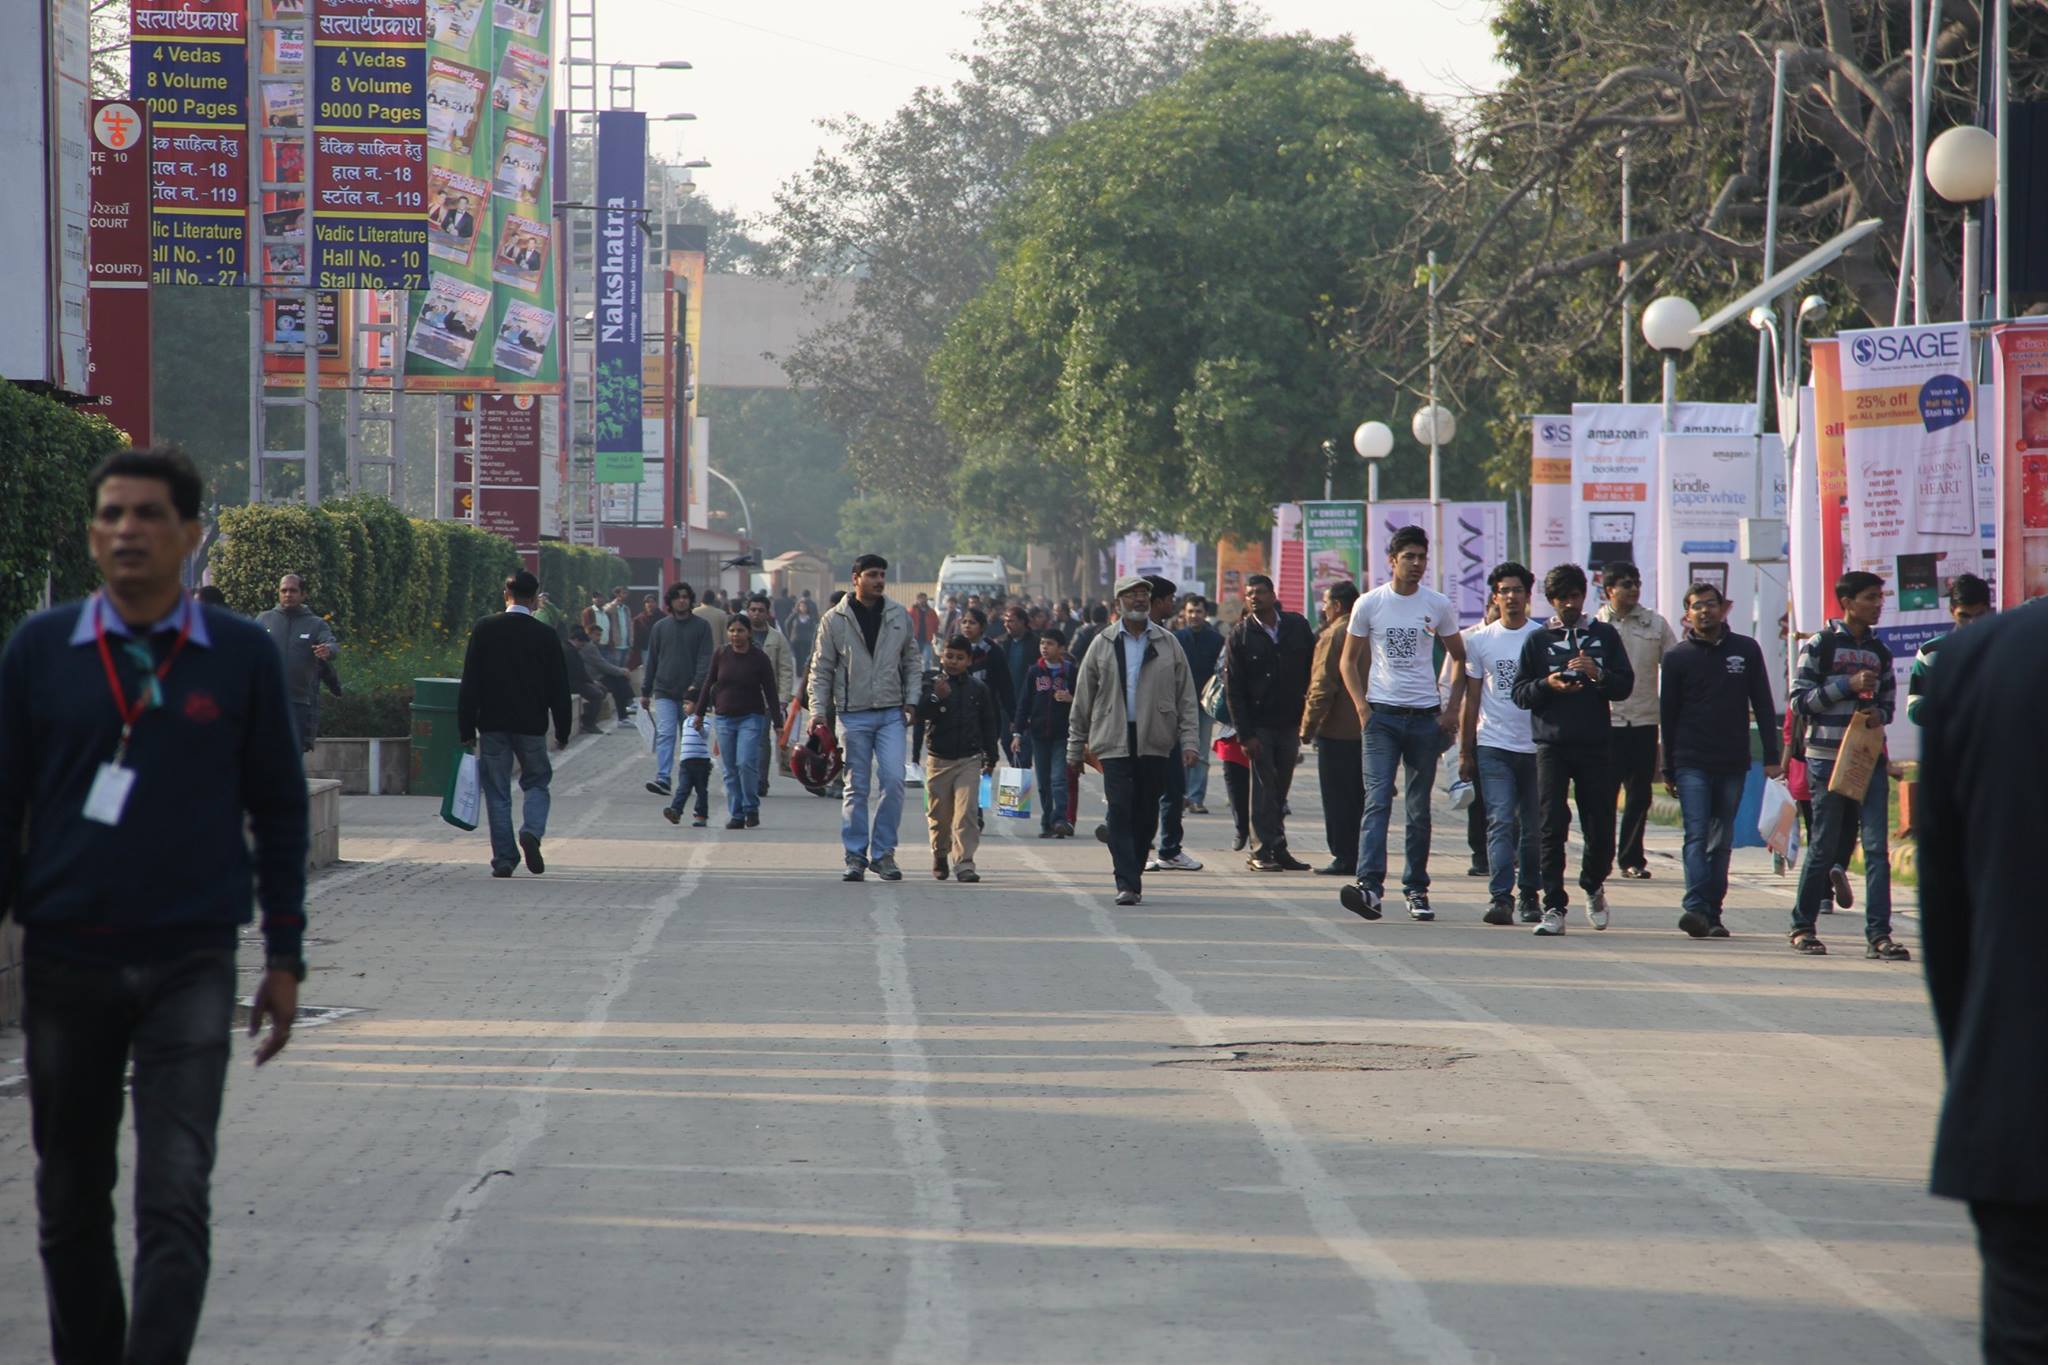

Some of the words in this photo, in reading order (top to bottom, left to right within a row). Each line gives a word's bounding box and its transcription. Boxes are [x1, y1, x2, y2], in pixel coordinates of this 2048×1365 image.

[320, 8, 422, 36] सत्यार्थप्रकाश
[153, 47, 163, 62] 4
[168, 46, 221, 63] Vedas
[337, 51, 347, 66] 4
[352, 51, 406, 68] Vedas
[147, 72, 157, 87] 8
[162, 72, 228, 89] Volume
[331, 77, 341, 92] 8
[346, 77, 412, 94] Volume
[137, 97, 177, 114] 000
[183, 98, 238, 119] Pages
[321, 102, 362, 118] 9000
[368, 103, 422, 123] Pages
[113, 153, 127, 162] 10
[90, 218, 128, 228] COURT
[174, 222, 242, 240] Literature
[315, 224, 354, 242] Vadic
[359, 225, 426, 243] Literature
[174, 246, 200, 263] No.
[216, 248, 235, 264] 10
[322, 249, 353, 267] Hall
[358, 250, 386, 267] No.
[401, 251, 420, 268] 10
[96, 263, 142, 276] COURT)
[175, 269, 202, 285] No.
[218, 271, 237, 286] 27
[602, 197, 625, 343] Nakshatra
[320, 272, 355, 288] Stall
[361, 272, 388, 289] No.
[403, 274, 422, 290] 27
[1878, 331, 1959, 362] SAGE
[1856, 395, 1885, 409] 25%
[1890, 392, 1907, 407] off
[1925, 409, 1941, 419] Stall
[1683, 424, 1744, 433] amazonin
[1592, 464, 1639, 474] bookstore
[1673, 479, 1710, 492] kindle
[1920, 480, 1960, 495] HEART
